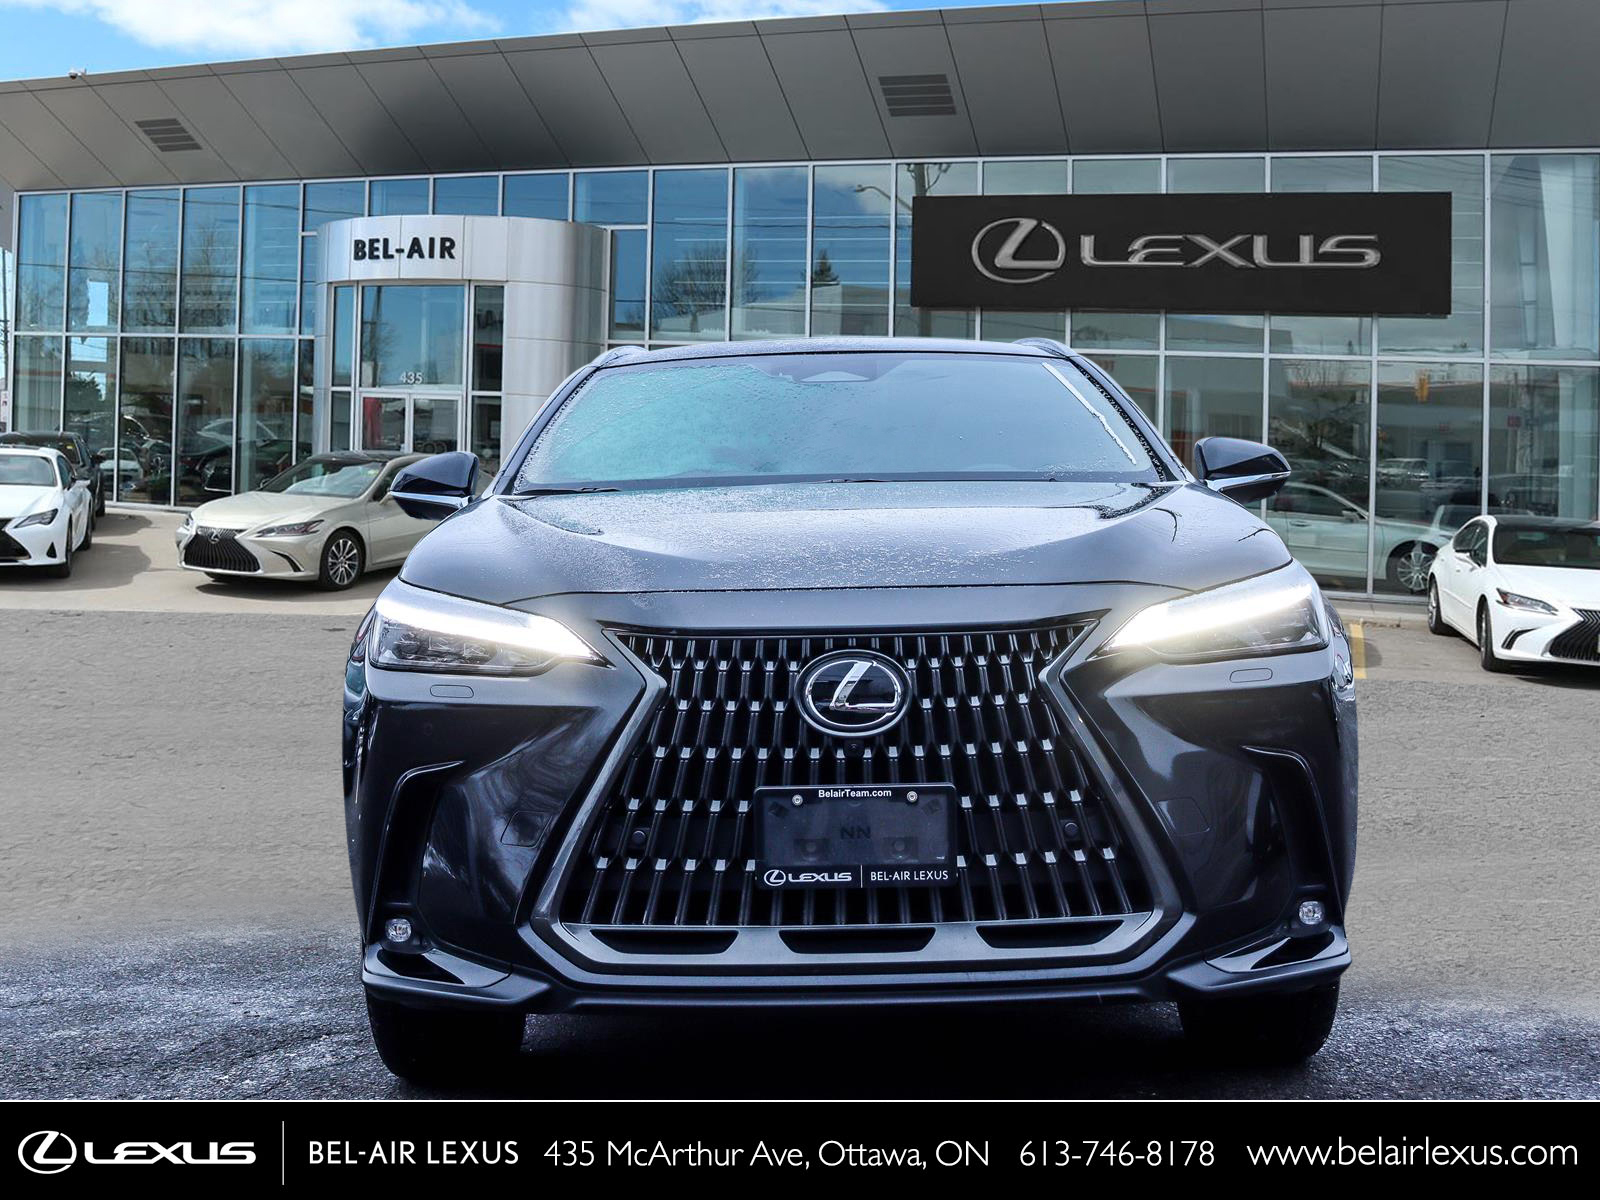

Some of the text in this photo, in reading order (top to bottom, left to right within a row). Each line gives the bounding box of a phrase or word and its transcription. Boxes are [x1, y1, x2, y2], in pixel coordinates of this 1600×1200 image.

[353, 236, 457, 261] BEL-AIR
[1080, 233, 1381, 268] LEXUS
[399, 371, 424, 385] 435
[817, 788, 893, 798] BelairTeam.com
[788, 872, 852, 883] LEXUS
[870, 870, 949, 881] BEL-AIR LEXUS
